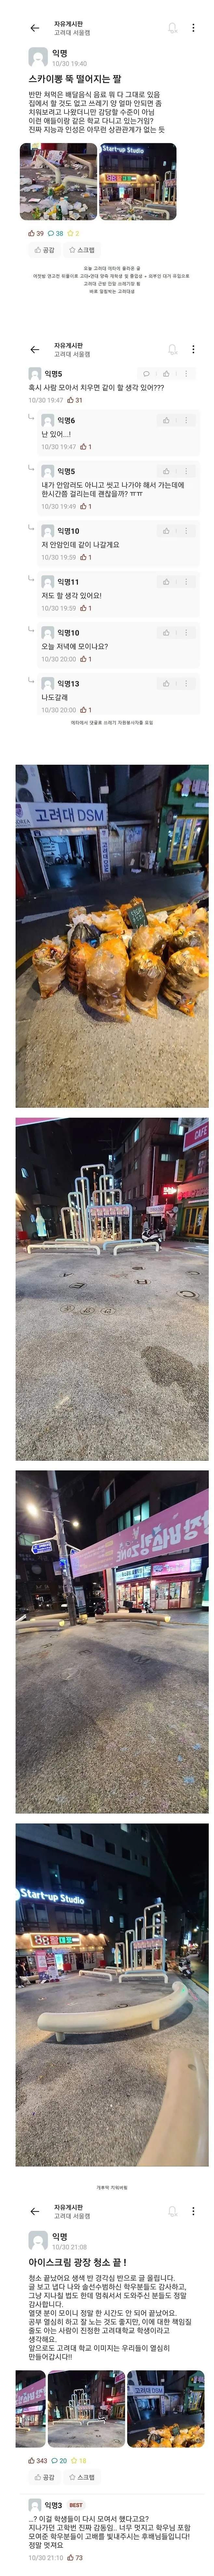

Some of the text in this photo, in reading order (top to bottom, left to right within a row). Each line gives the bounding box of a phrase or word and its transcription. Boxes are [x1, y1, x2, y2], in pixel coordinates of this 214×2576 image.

[29, 75, 121, 83] 스카이뽕 뚝 떨어지는 짤
[35, 808, 104, 823] 고려대 DSM
[194, 1125, 208, 1140] CAFE
[20, 1888, 85, 1904] Start-up Studio
[29, 2258, 71, 2267] 아이스크림
[74, 2258, 91, 2267] 광장
[94, 2258, 110, 2267] 청소
[113, 2259, 121, 2267] 끝
